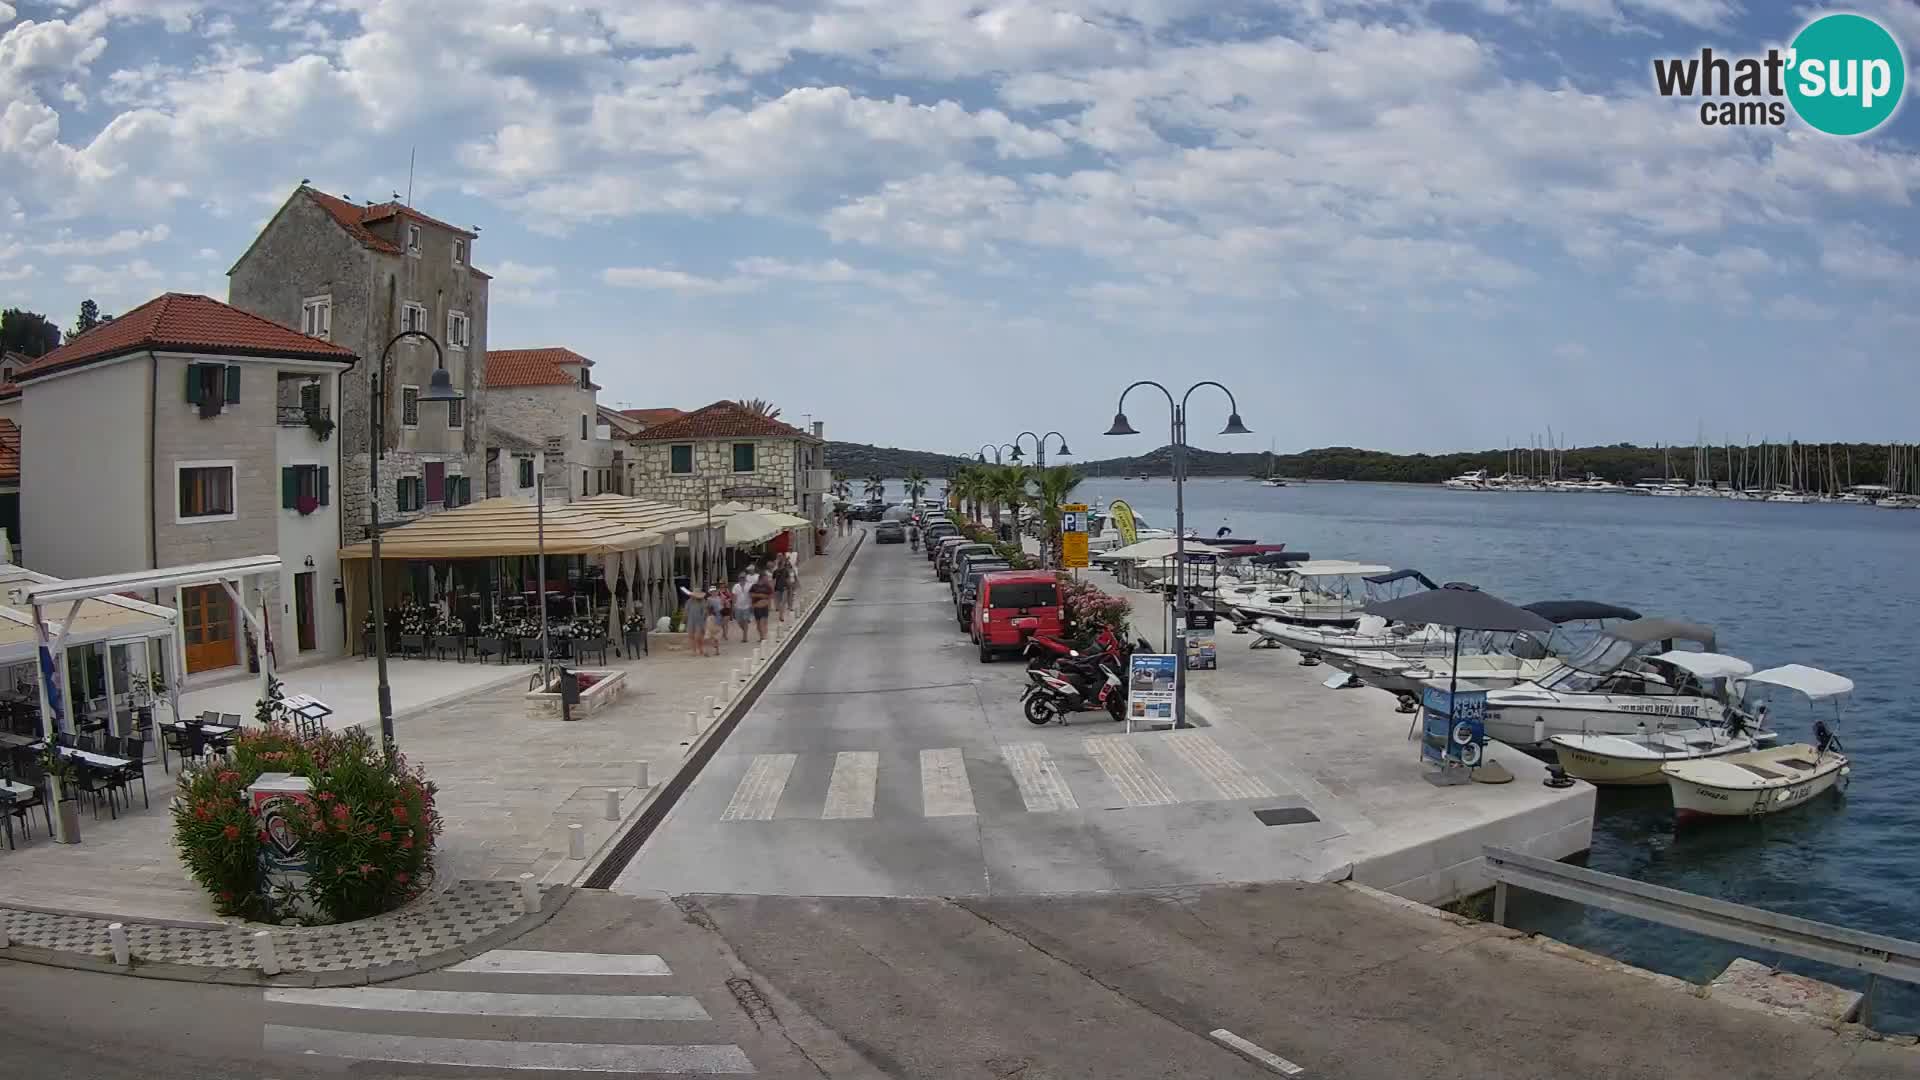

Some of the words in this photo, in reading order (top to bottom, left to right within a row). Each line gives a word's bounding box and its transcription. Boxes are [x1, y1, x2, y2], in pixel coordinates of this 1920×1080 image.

[1065, 514, 1075, 530] P
[1453, 697, 1485, 709] RENT
[1453, 710, 1460, 719] A
[1461, 709, 1484, 719] BOAT
[1680, 705, 1700, 717] BOAT
